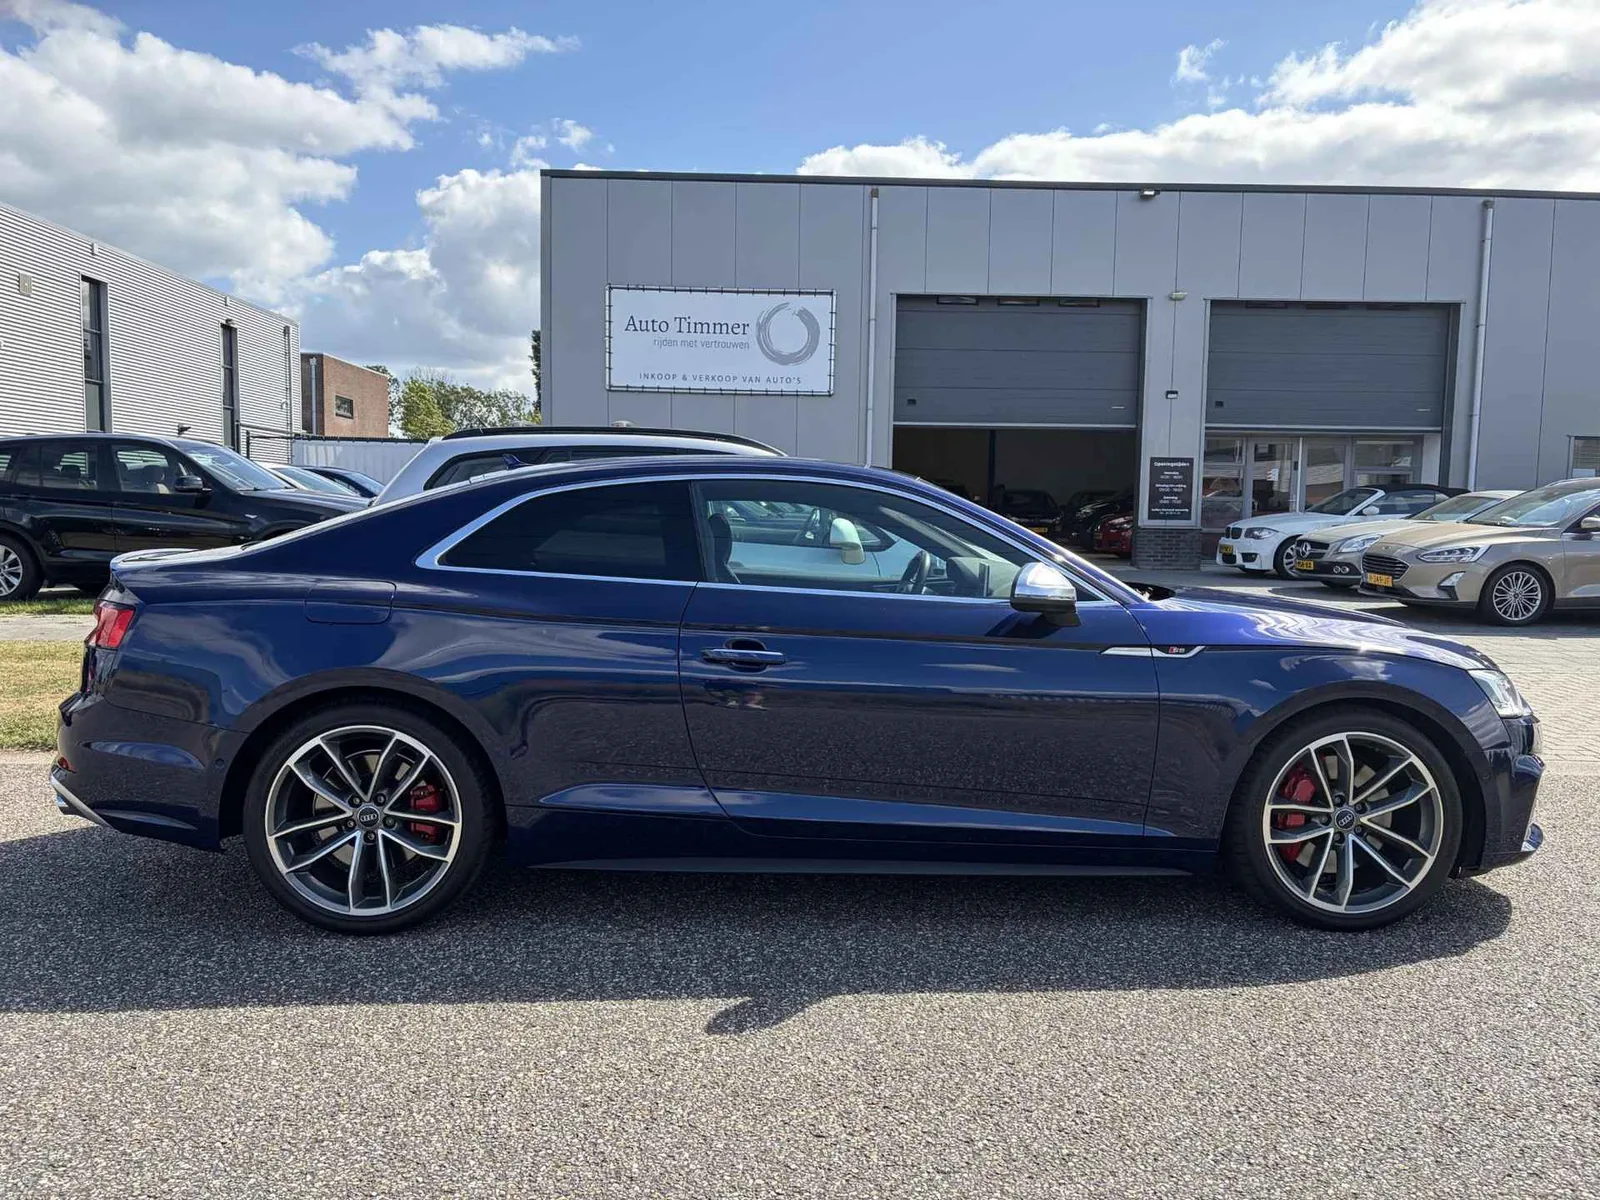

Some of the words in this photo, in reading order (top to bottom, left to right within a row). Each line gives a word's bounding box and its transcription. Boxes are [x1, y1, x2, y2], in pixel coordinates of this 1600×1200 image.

[624, 315, 669, 333] Auto
[674, 316, 750, 335] Timmer
[653, 338, 678, 350] rijden
[680, 339, 698, 348] met
[701, 339, 750, 350] vertrouwen
[639, 372, 677, 381] INKOOP
[682, 374, 688, 382] &
[692, 374, 738, 383] VERKOOP
[742, 376, 761, 384] VAN
[765, 376, 802, 385] AUTO'S
